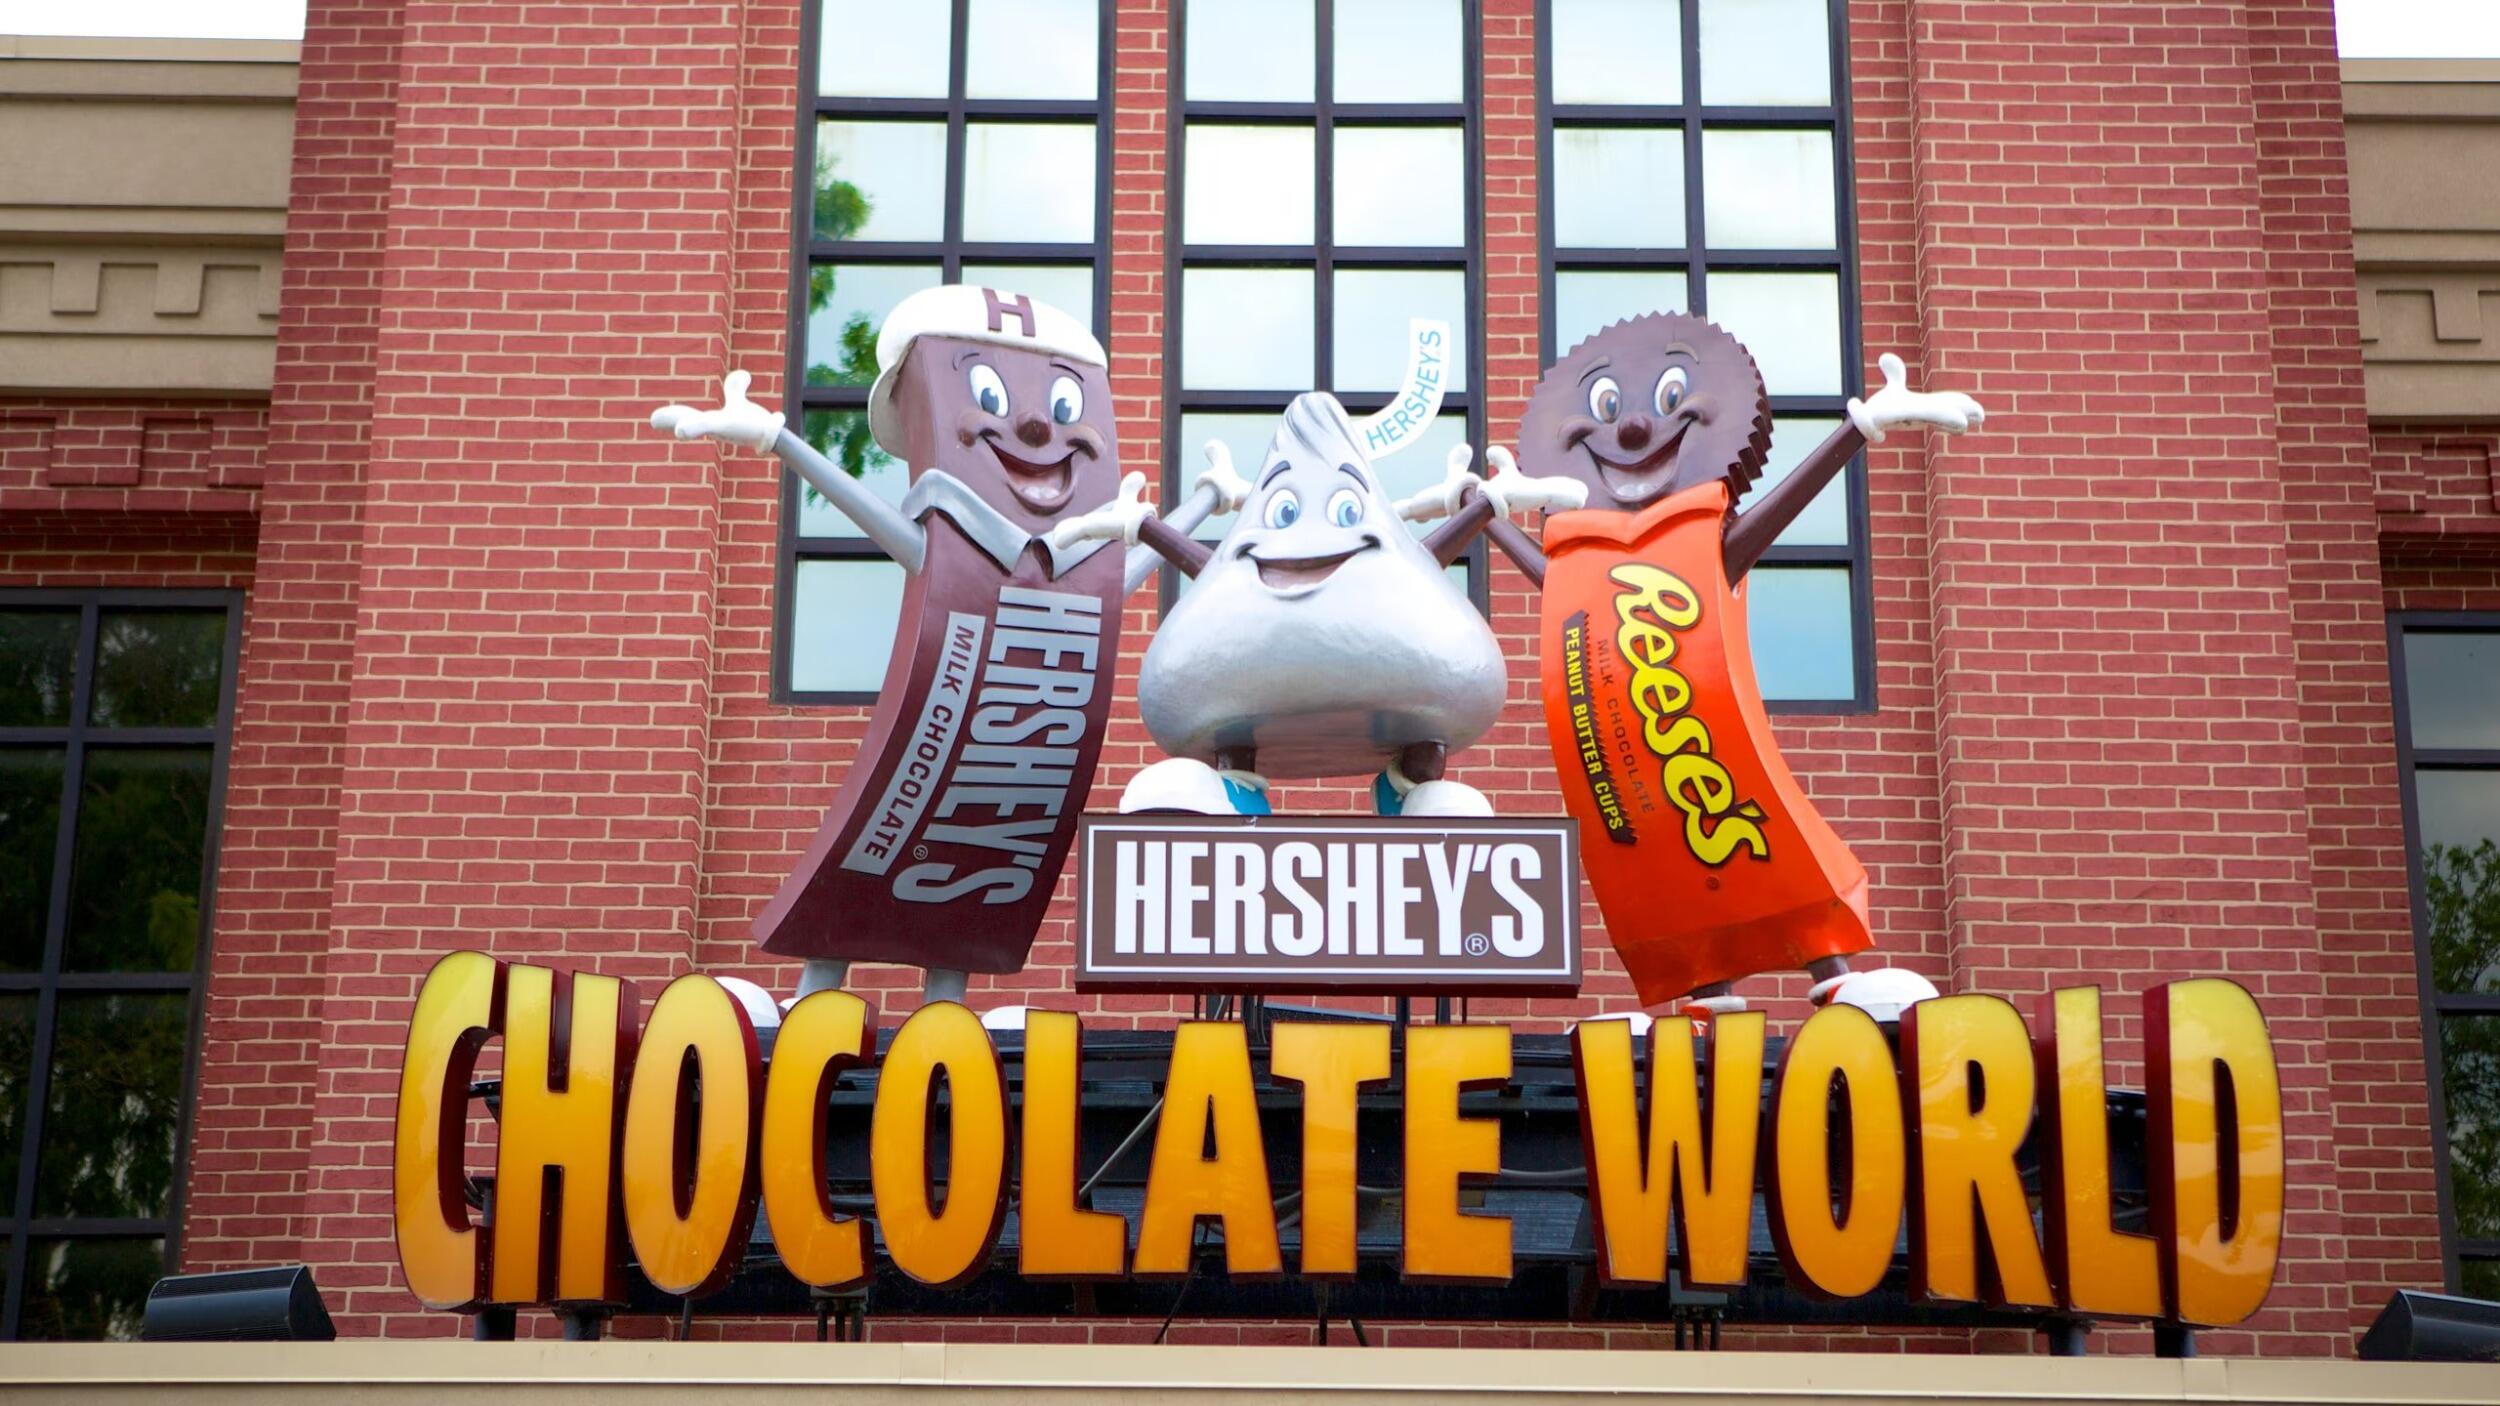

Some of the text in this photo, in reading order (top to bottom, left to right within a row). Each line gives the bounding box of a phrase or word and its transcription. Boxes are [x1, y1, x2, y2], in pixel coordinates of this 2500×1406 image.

[982, 287, 1036, 338] H
[1365, 330, 1442, 450] HERSHEY'S
[863, 624, 975, 861] MILK CHOCOLATE
[891, 586, 1102, 905] HERSHEY'S
[1565, 627, 1624, 831] PEANUT BUTTER CUPS
[1598, 638, 1655, 813] MILK CHOCOLATE
[1608, 563, 1770, 867] Reese's
[1115, 841, 1545, 958] HERSHEY'S
[394, 951, 2286, 1326] CHOCOLATE WORLD
